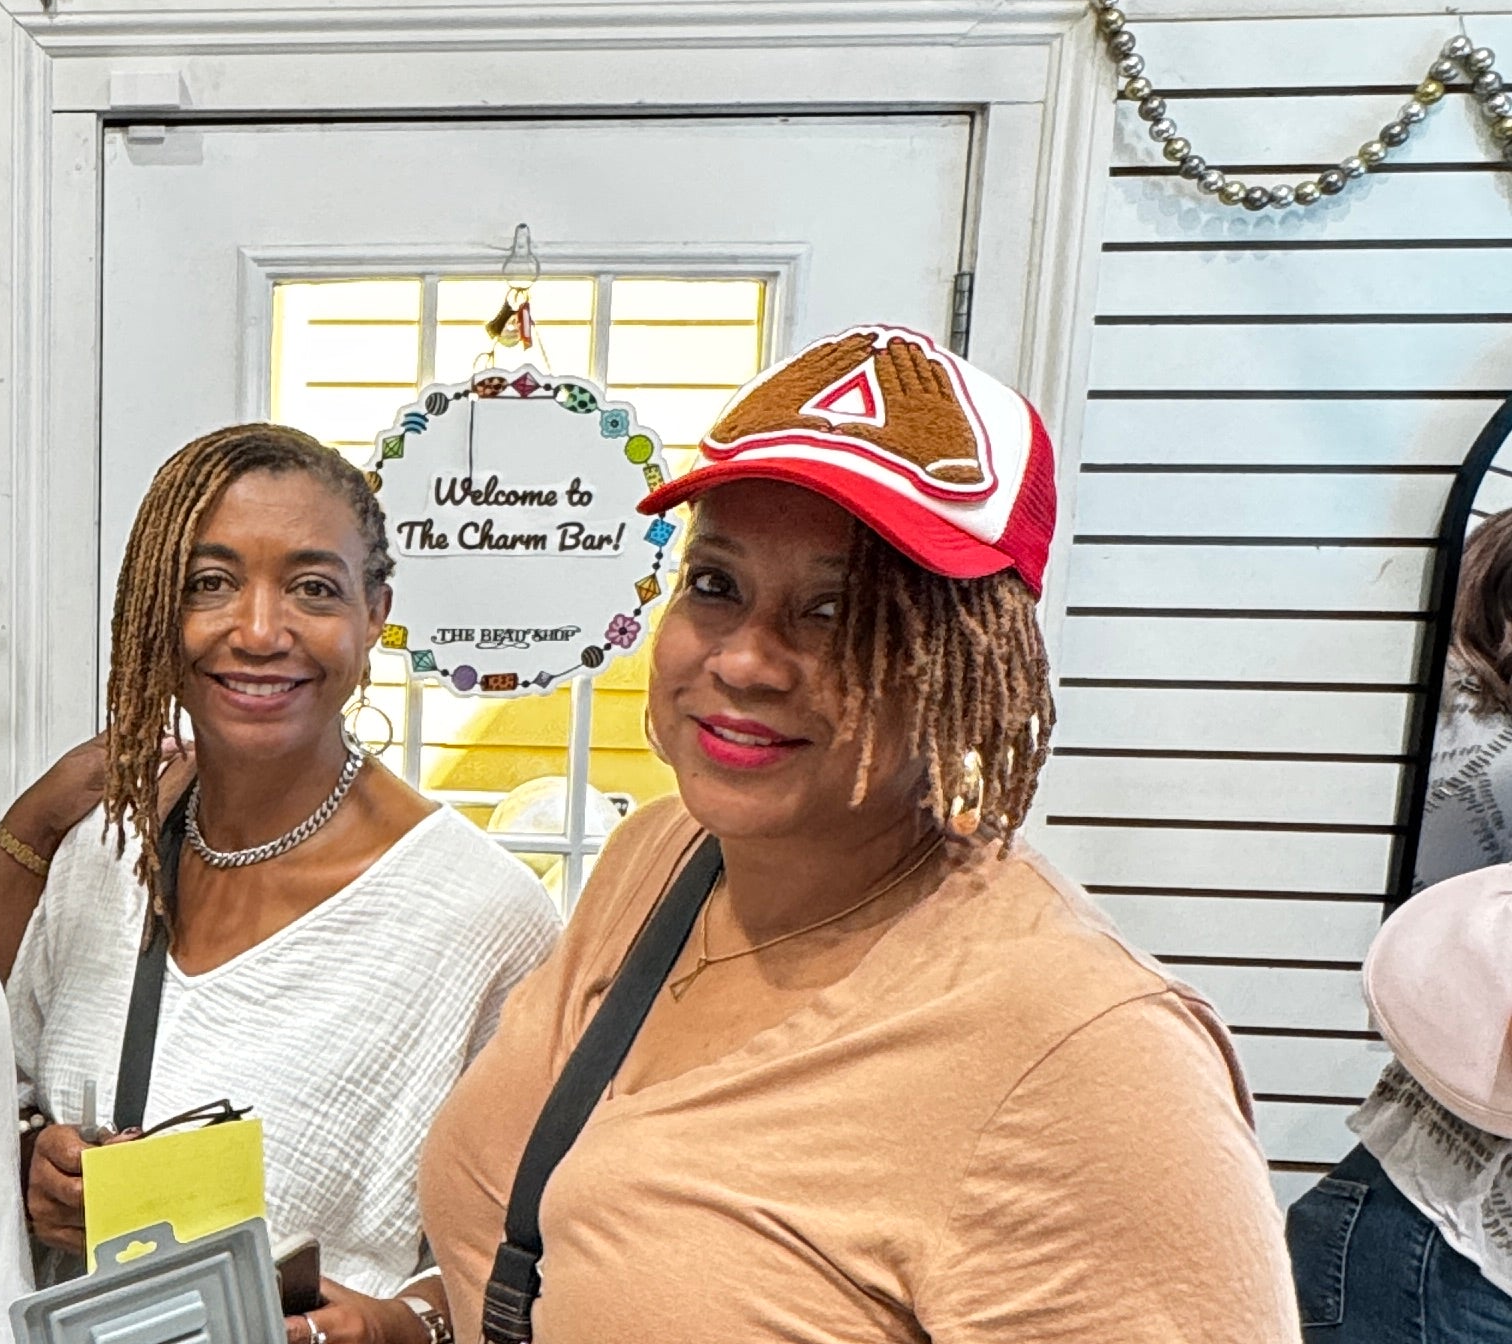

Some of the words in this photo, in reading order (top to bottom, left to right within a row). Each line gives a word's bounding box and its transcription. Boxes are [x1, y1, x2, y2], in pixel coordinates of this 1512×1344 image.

[434, 474, 558, 506] Welcome
[565, 476, 593, 507] to
[396, 518, 449, 550] The
[457, 518, 548, 550] Charm
[556, 521, 627, 552] Bar!
[430, 628, 475, 645] THE
[475, 628, 531, 650] BEAD
[531, 624, 582, 643] SHOP
